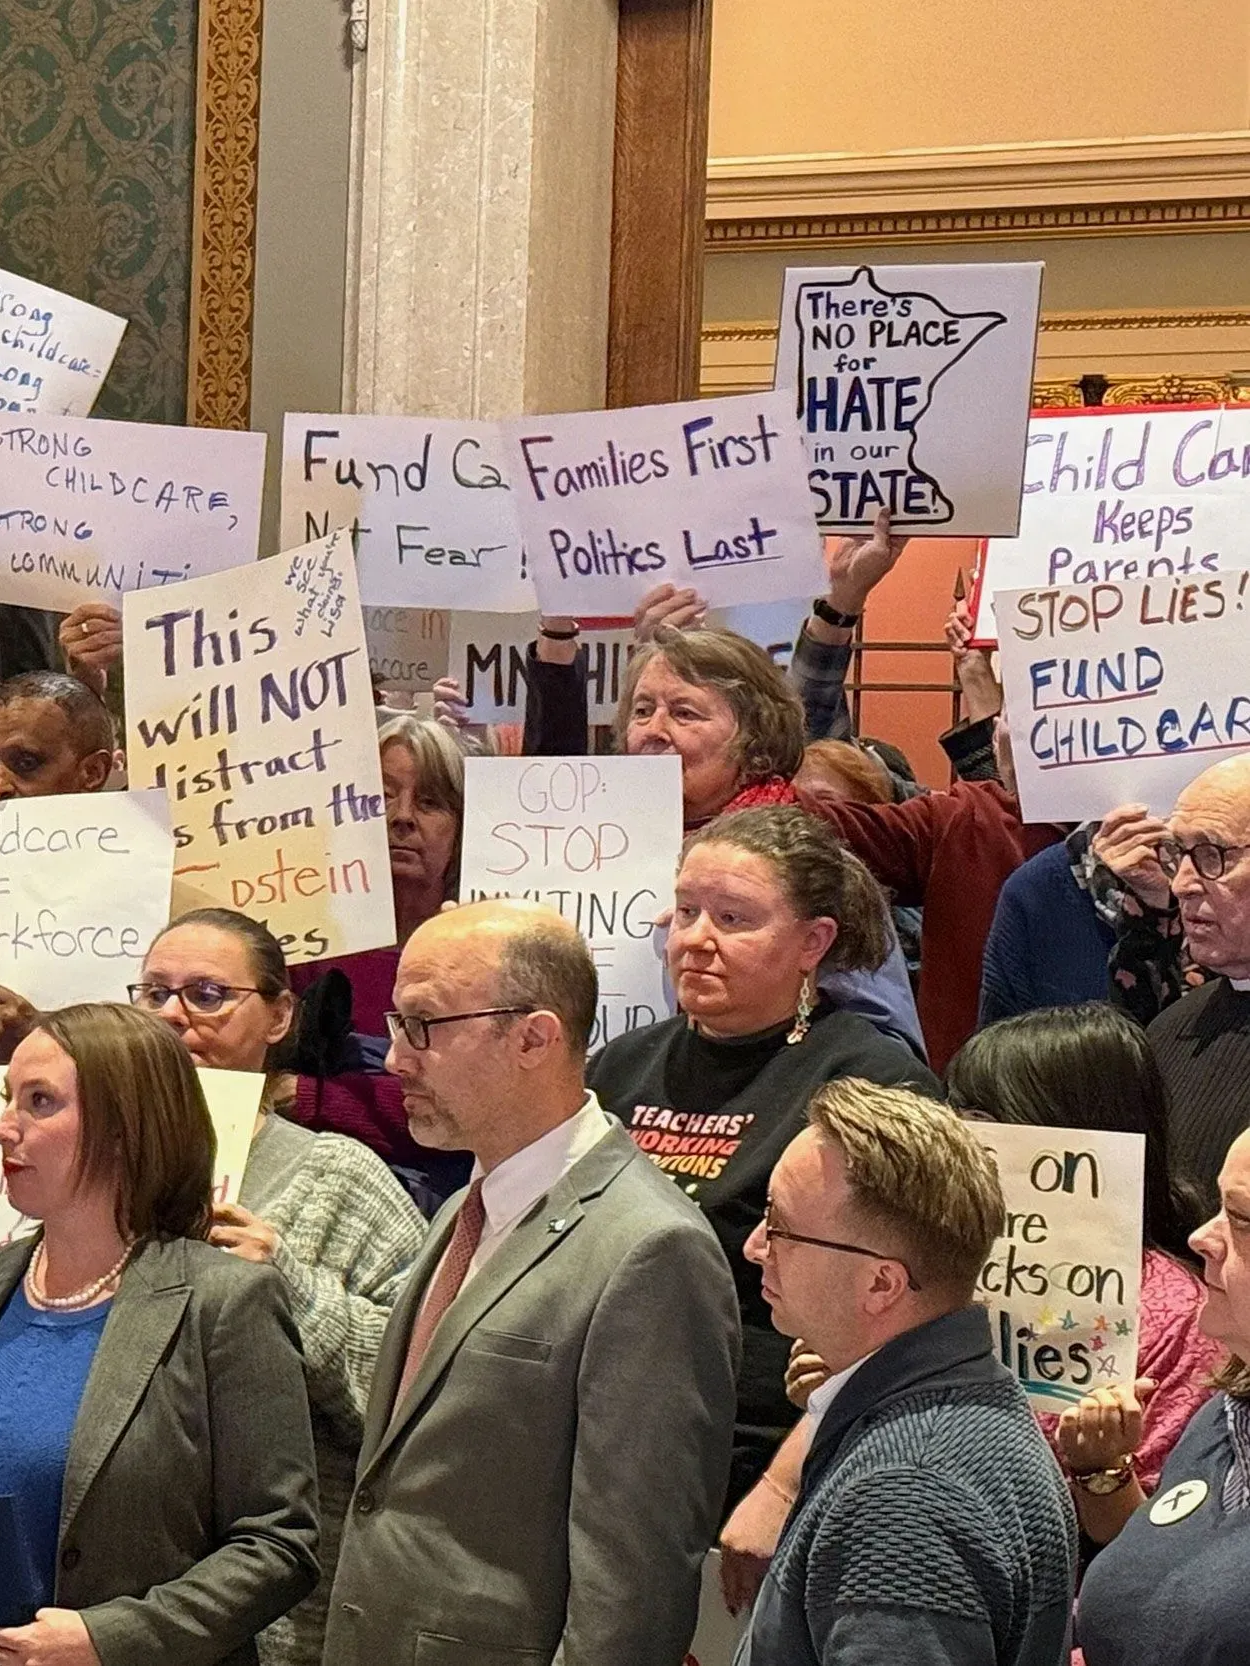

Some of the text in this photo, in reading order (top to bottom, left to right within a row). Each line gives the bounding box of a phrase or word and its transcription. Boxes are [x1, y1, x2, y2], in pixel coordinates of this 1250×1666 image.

[806, 290, 913, 320] There's
[811, 320, 962, 350] NO PLACE
[833, 354, 878, 373] for
[806, 376, 922, 433] HATE
[303, 429, 510, 497] Fund Ca
[519, 414, 779, 502] Families First
[814, 443, 900, 463] in our
[45, 465, 239, 531] CHILDCARE,
[807, 468, 940, 519] STATE!
[304, 509, 372, 556] Nt
[547, 516, 778, 580] Politics Last
[1092, 498, 1194, 552] Keeps
[1048, 546, 1219, 586] Parents
[1011, 584, 1124, 642] STOP
[145, 605, 279, 678] This
[136, 646, 362, 750] will NOT
[1029, 647, 1165, 709] FUND
[1030, 696, 1250, 765] CHILDCAR
[208, 799, 315, 847] from
[326, 781, 387, 828] the
[517, 761, 609, 814] GOP:
[485, 822, 630, 876] STOP
[173, 848, 371, 908] pstein
[470, 888, 658, 939] TING
[631, 1104, 756, 1136] TEACHERS'
[1029, 1149, 1100, 1199] on
[1066, 1262, 1125, 1306] on
